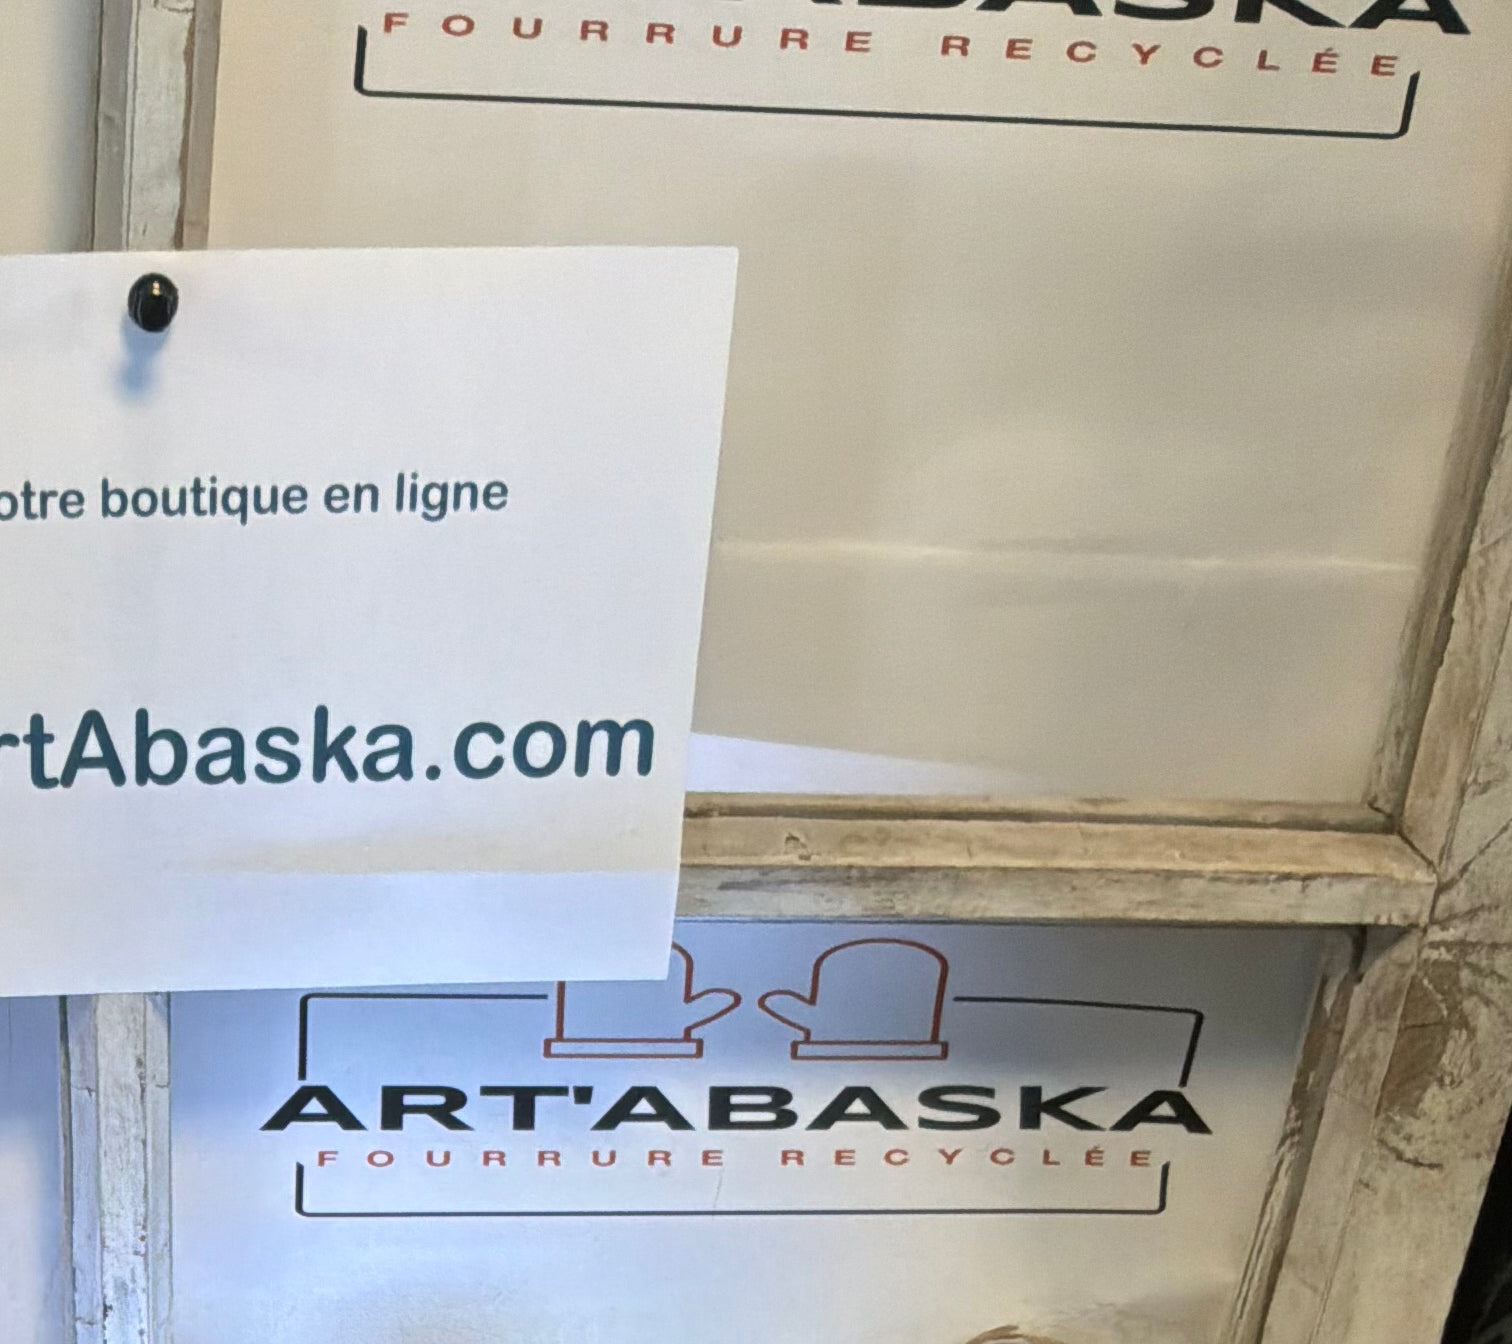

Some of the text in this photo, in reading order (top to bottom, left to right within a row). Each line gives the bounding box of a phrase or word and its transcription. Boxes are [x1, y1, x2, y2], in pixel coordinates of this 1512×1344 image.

[383, 12, 873, 53] FOURRURE
[939, 35, 1399, 77] RECYCLÉE
[100, 476, 309, 526] boutique
[323, 484, 380, 513] en
[395, 472, 509, 522] ligne
[260, 1084, 1213, 1135] ART'ABASKA
[316, 1145, 1152, 1168] FOURRURE RECYCLÉE
